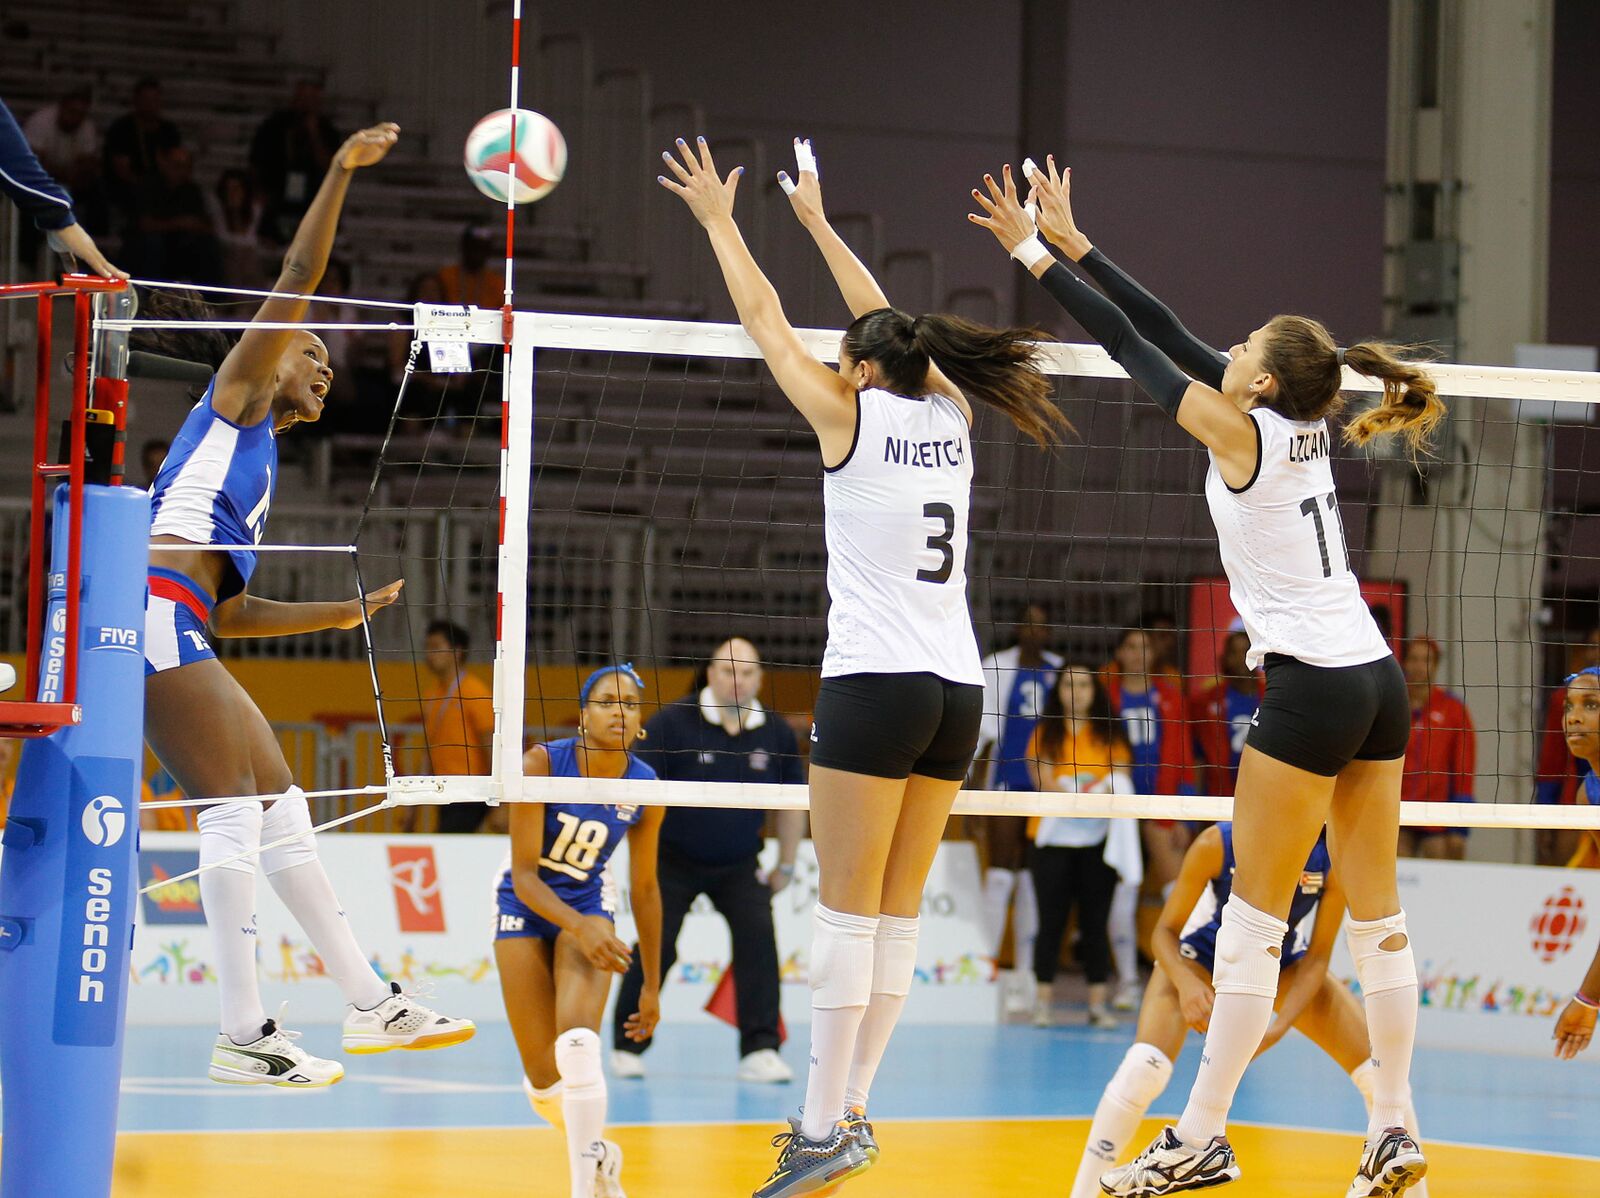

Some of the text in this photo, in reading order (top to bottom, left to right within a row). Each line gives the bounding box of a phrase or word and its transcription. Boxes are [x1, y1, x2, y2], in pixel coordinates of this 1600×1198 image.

[438, 309, 471, 317] Senoh
[916, 502, 955, 584] 3
[100, 626, 138, 646] FIVB
[1019, 680, 1045, 717] 3
[548, 811, 609, 871] 18
